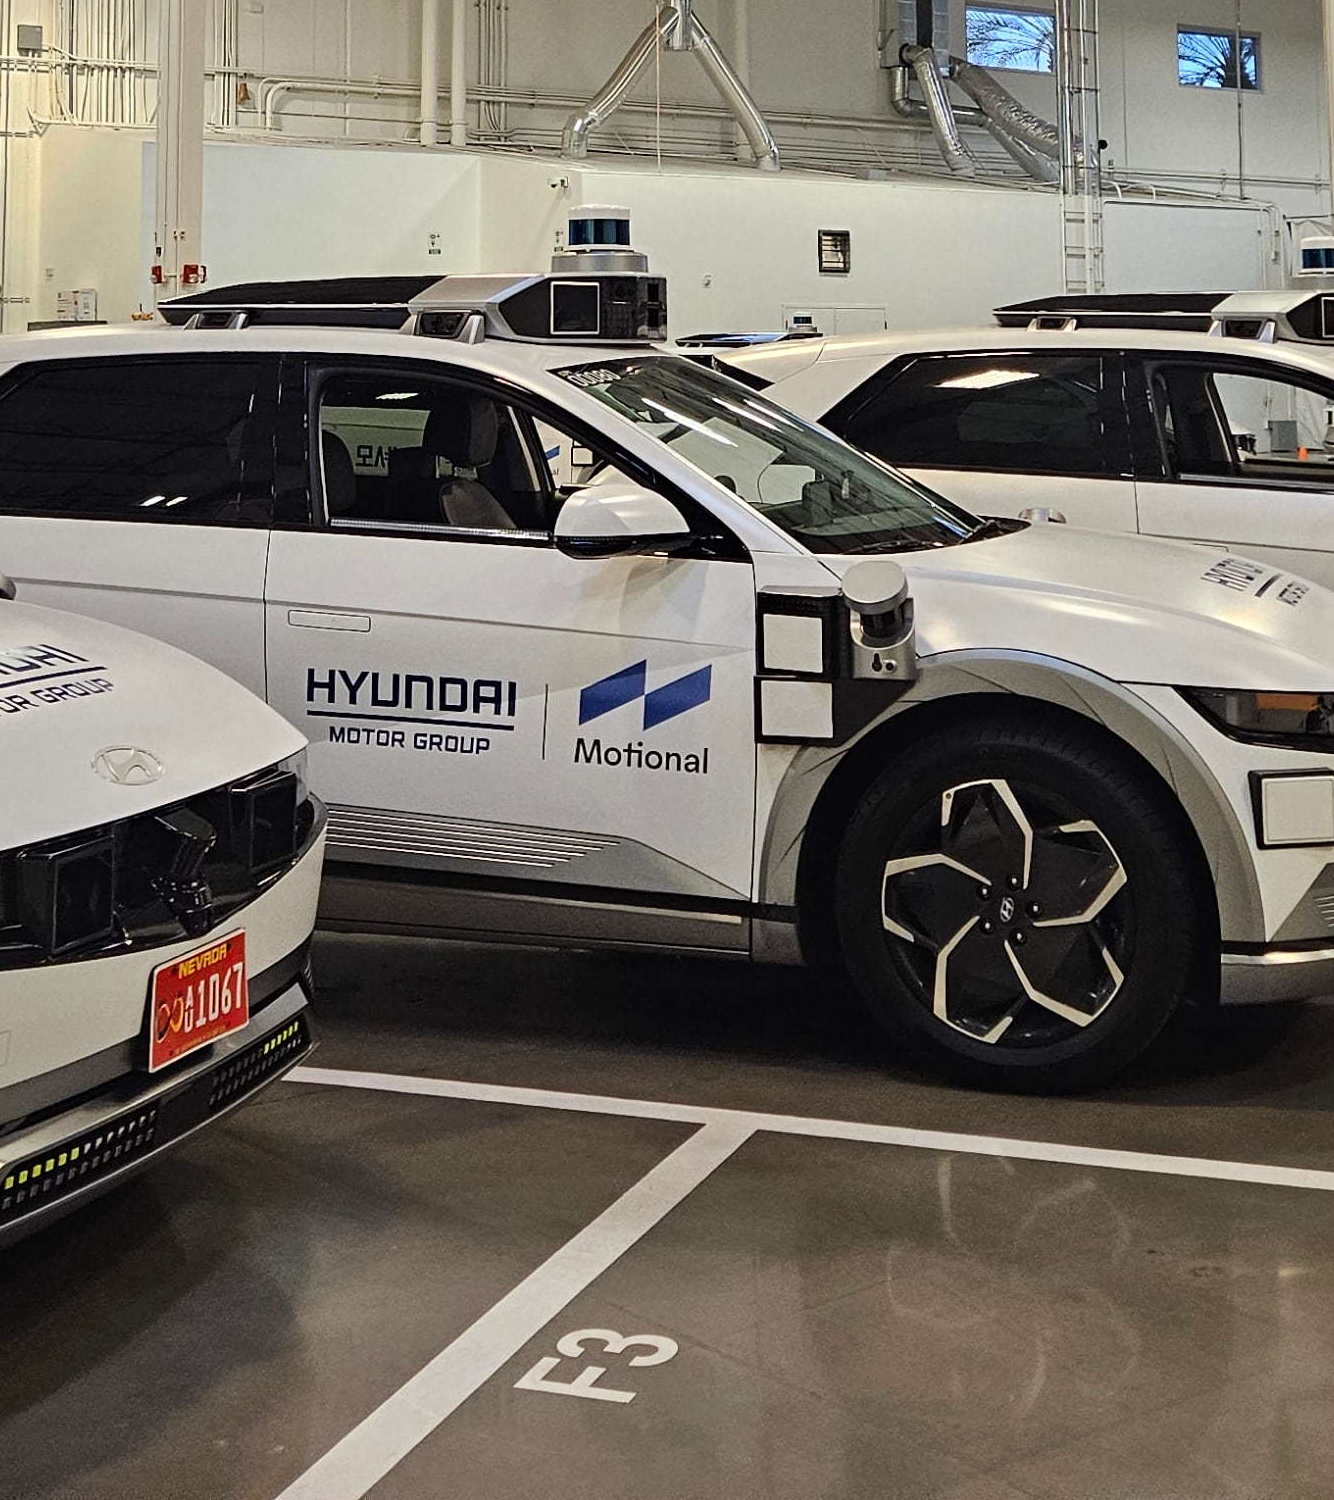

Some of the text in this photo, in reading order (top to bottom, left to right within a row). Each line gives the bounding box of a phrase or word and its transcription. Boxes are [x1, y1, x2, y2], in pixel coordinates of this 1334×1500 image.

[29, 677, 115, 704] GROUP
[306, 667, 517, 717] HYUNDAI
[328, 725, 491, 755] MOTOR GROUP
[573, 737, 709, 775] Motional
[178, 942, 228, 980] NEVADA
[512, 1328, 680, 1405] F3
